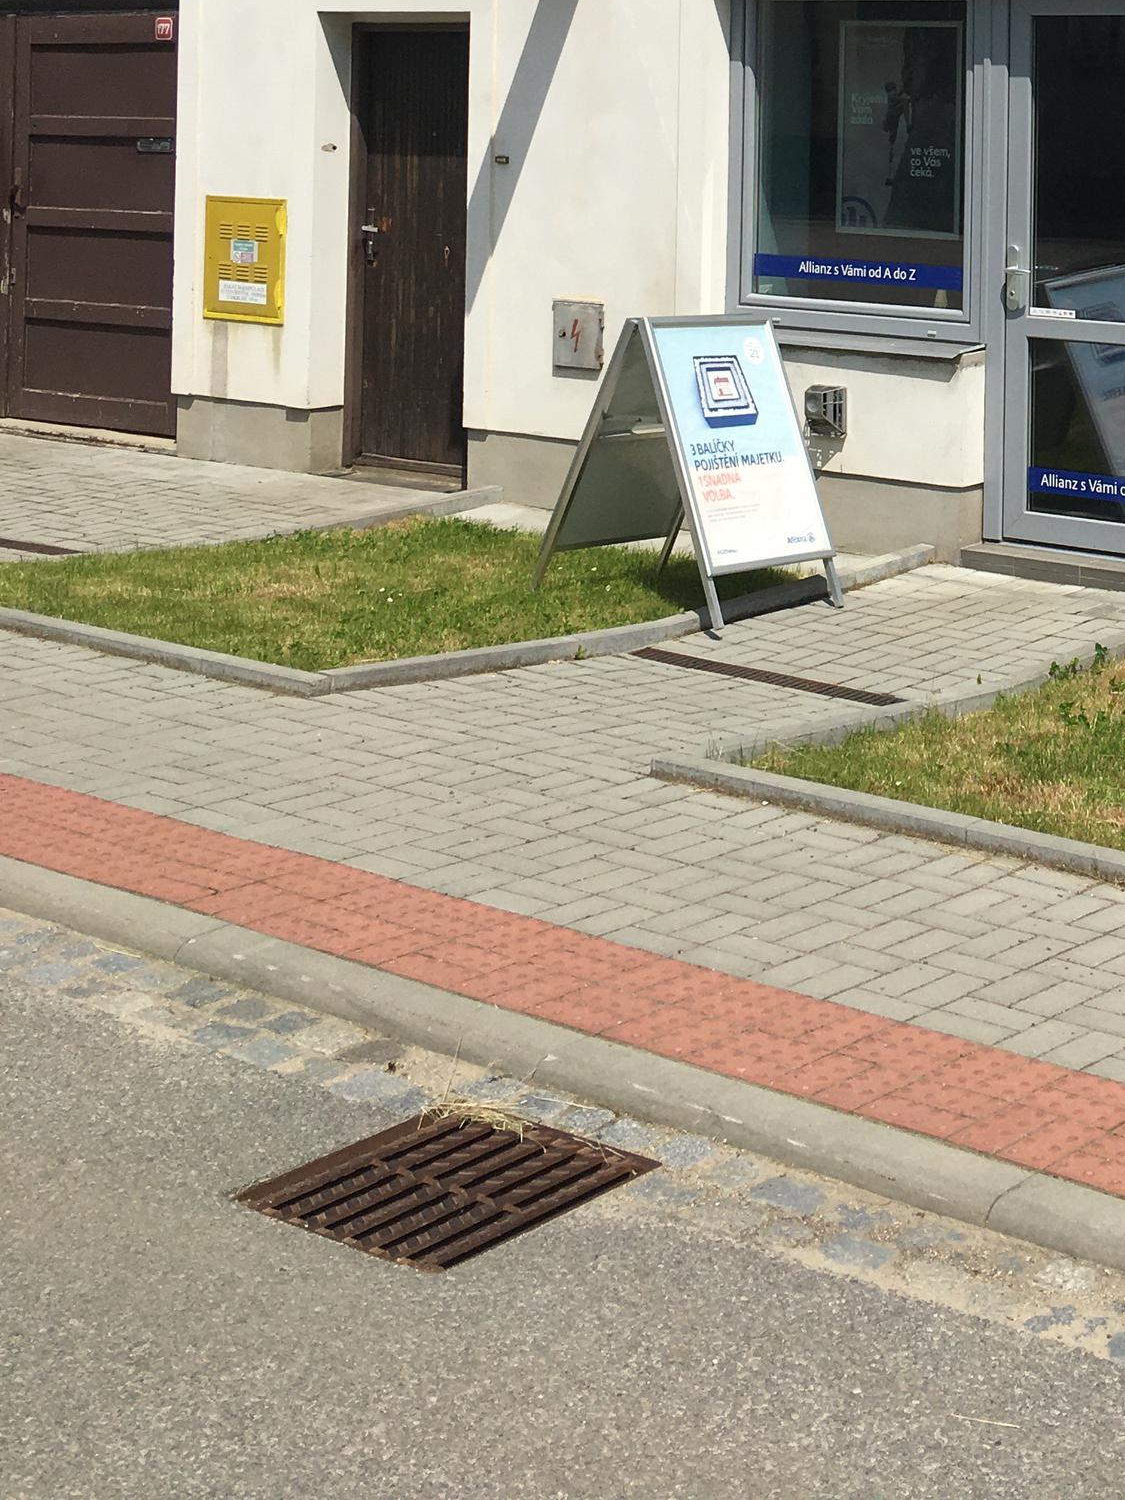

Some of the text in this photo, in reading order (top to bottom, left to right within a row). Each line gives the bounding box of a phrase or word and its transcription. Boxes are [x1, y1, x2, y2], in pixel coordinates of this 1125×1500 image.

[910, 145, 951, 159] ve všem,
[910, 156, 941, 167] co Vás
[798, 261, 916, 281] Allianz s Vámi od A do Z
[690, 438, 735, 456] 3 BALÍČKY
[694, 451, 784, 471] POJIŠTĚNÍ MAJETKU.
[1040, 474, 1078, 490] Allianz
[1080, 480, 1086, 491] s
[1089, 479, 1118, 495] Vámi
